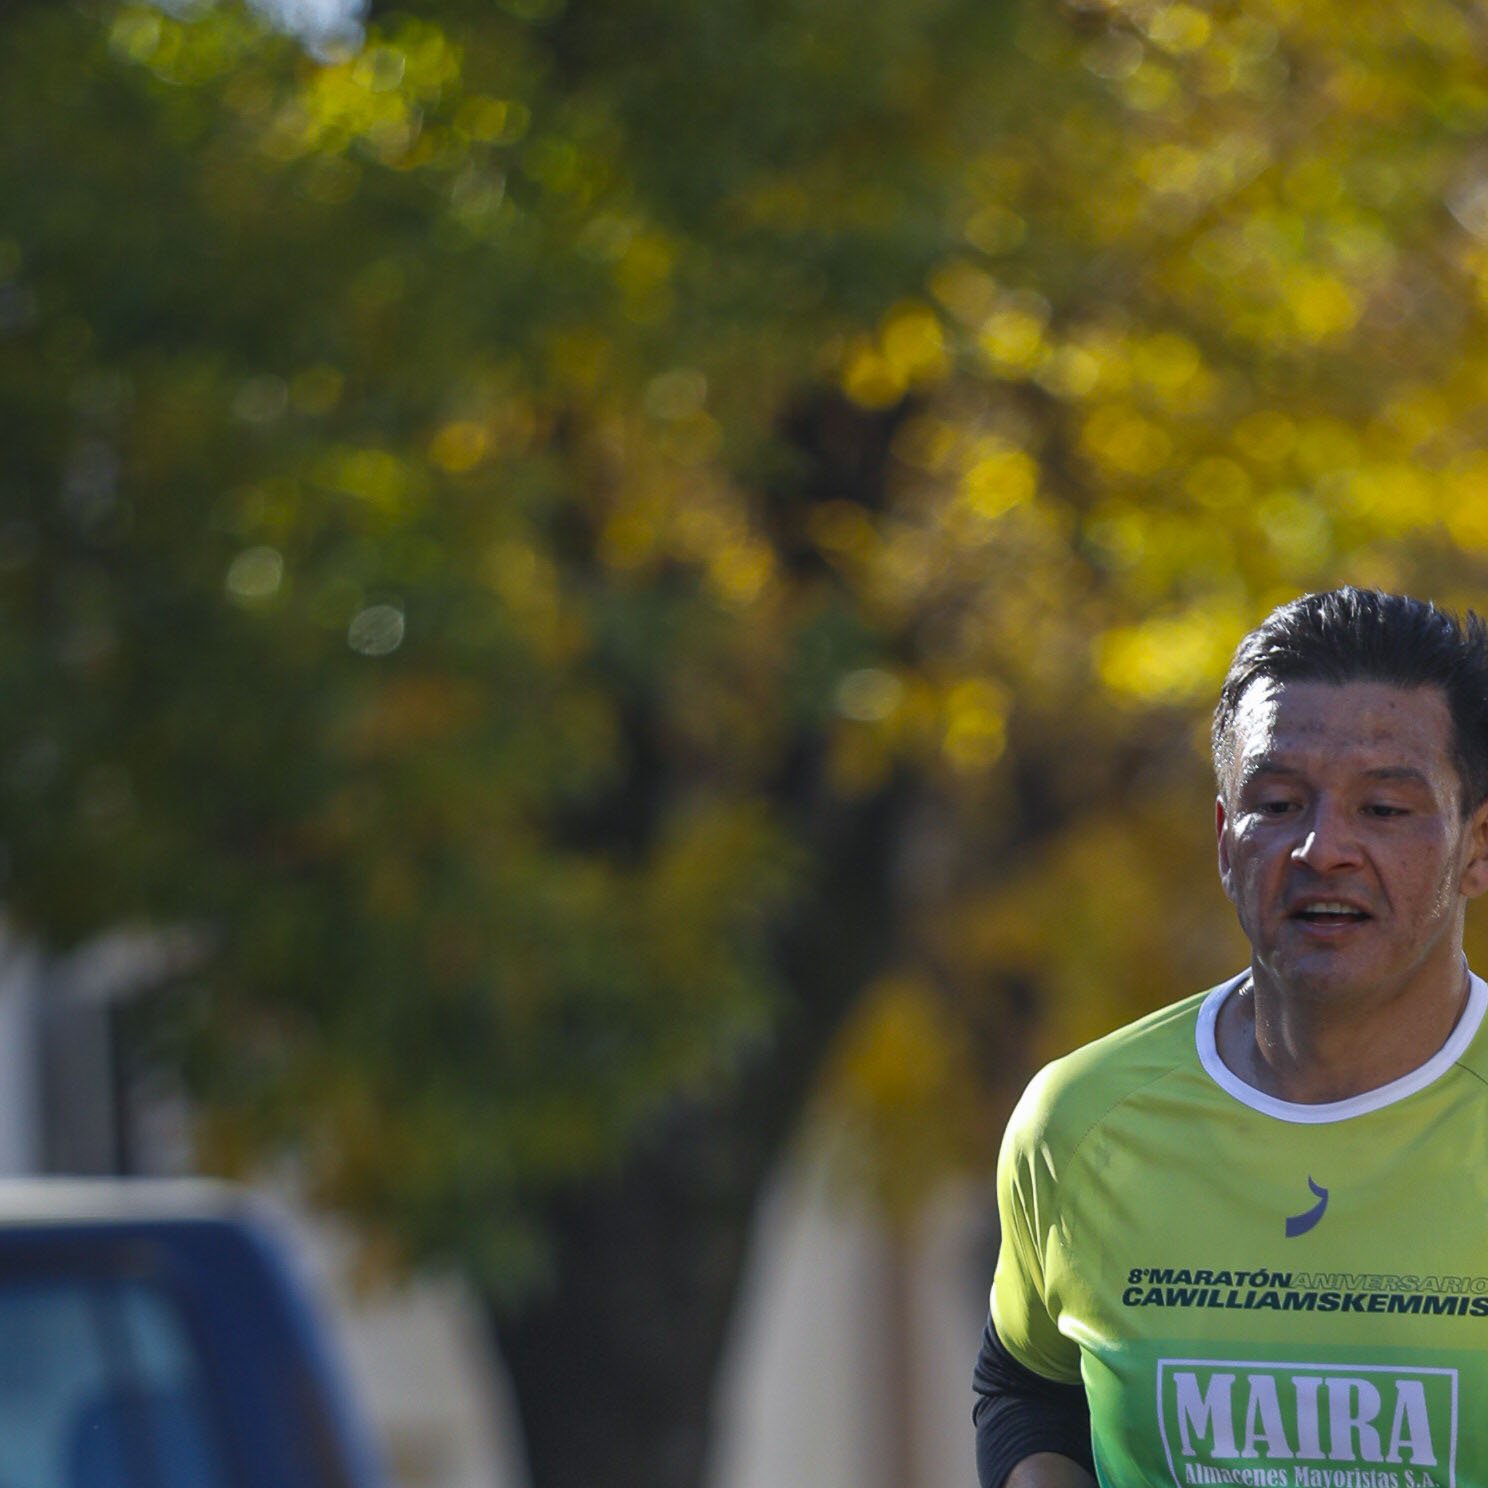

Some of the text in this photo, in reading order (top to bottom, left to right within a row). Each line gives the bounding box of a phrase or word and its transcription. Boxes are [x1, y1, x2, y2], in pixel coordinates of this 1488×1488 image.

[1173, 1372, 1437, 1466] MAIRA
[1185, 1462, 1288, 1488] Almacenes
[1404, 1469, 1440, 1488] S.A.
